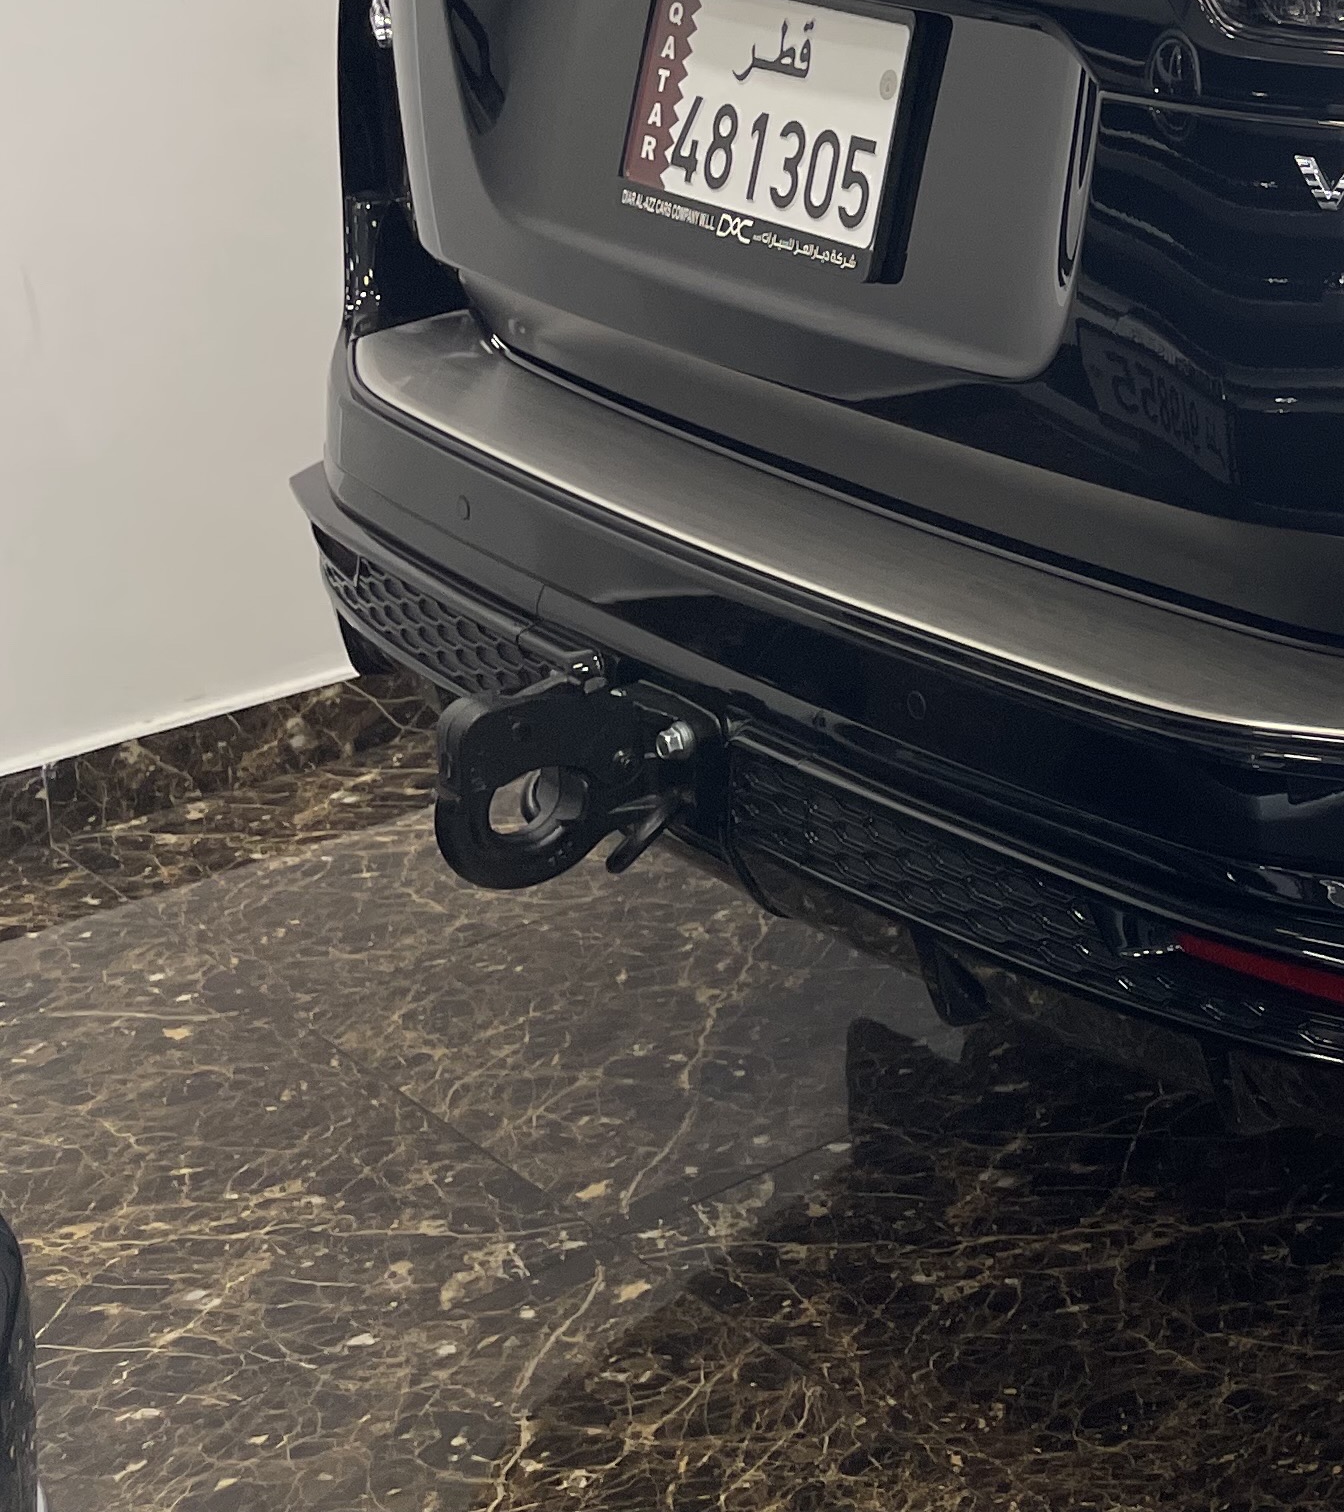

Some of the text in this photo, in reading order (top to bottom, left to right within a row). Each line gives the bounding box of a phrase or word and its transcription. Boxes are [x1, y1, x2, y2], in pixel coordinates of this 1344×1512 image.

[639, 1, 685, 162] QATAR
[731, 17, 815, 82] قطر
[655, 199, 673, 218] CARS
[671, 204, 702, 226] COMPANY
[670, 95, 877, 230] 481305
